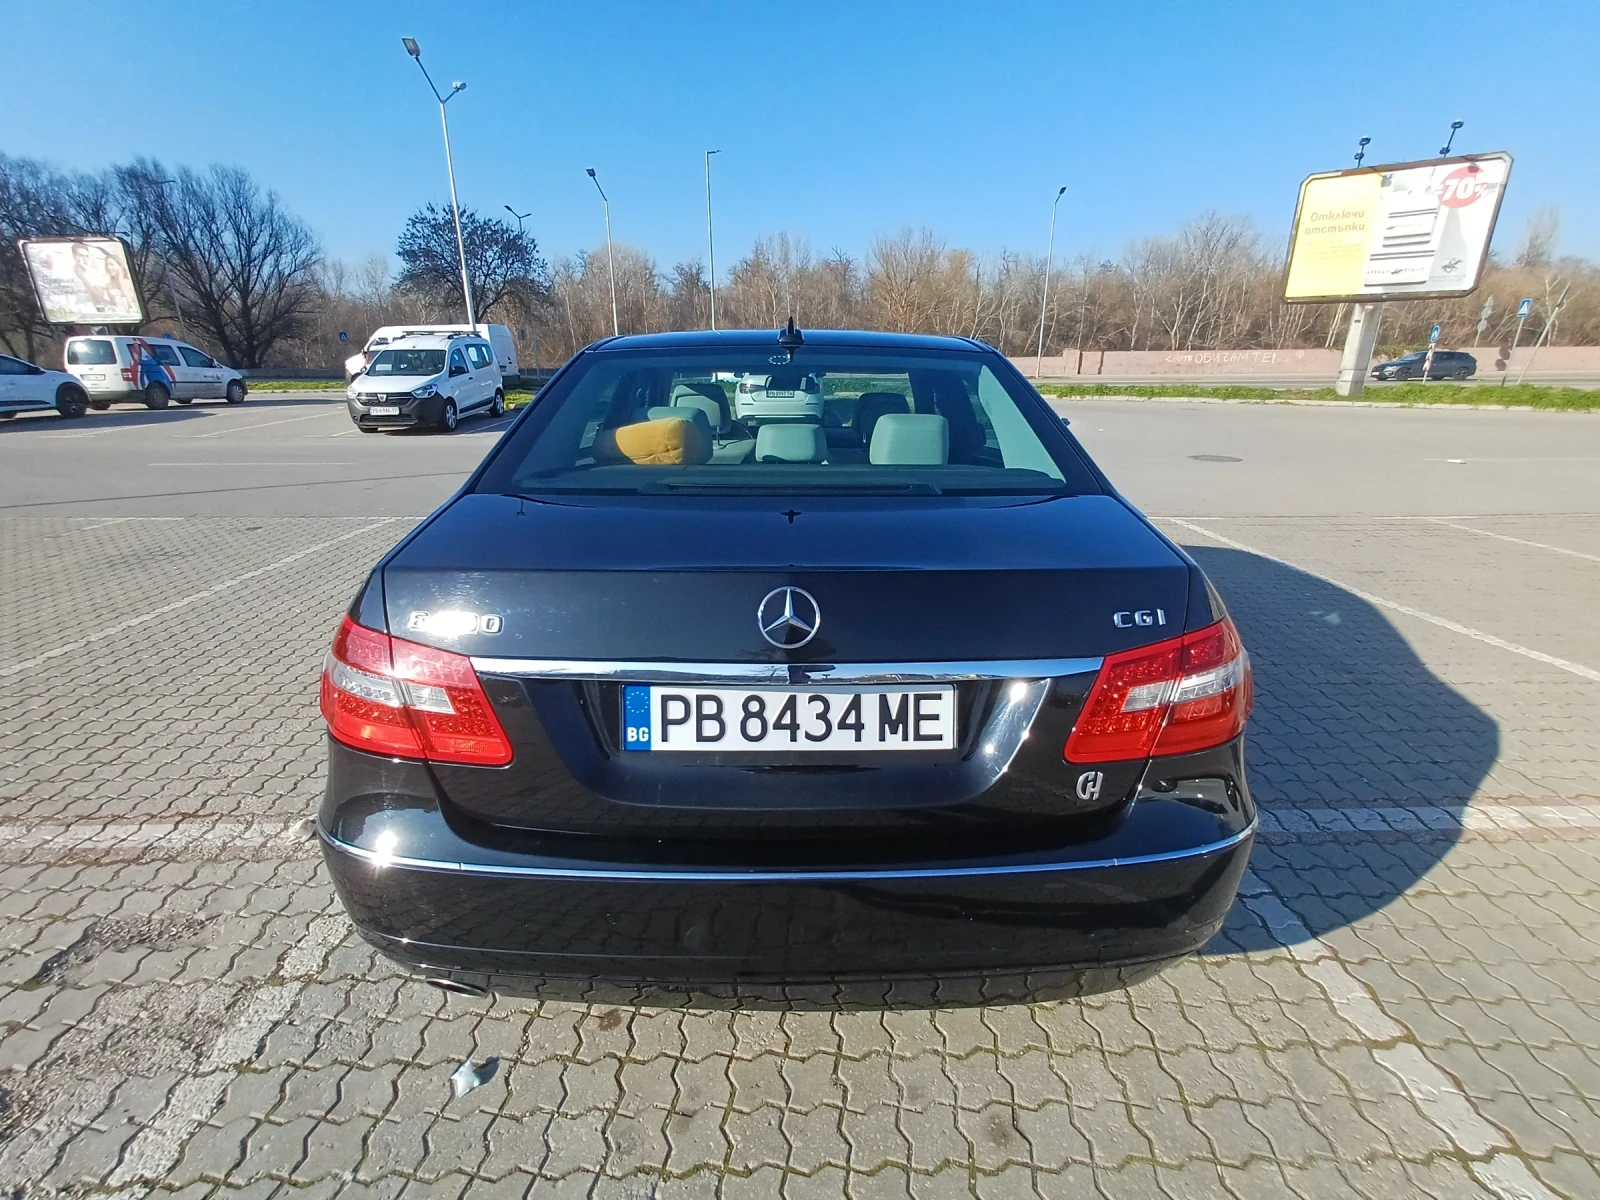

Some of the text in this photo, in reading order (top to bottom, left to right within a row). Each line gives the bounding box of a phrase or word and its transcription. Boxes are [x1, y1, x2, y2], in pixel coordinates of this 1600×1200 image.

[1310, 209, 1365, 222] Отключи
[1305, 221, 1366, 235] отстъпки
[1113, 608, 1167, 628] CGI
[660, 693, 943, 743] PB 8434 ME
[627, 726, 649, 742] BG
